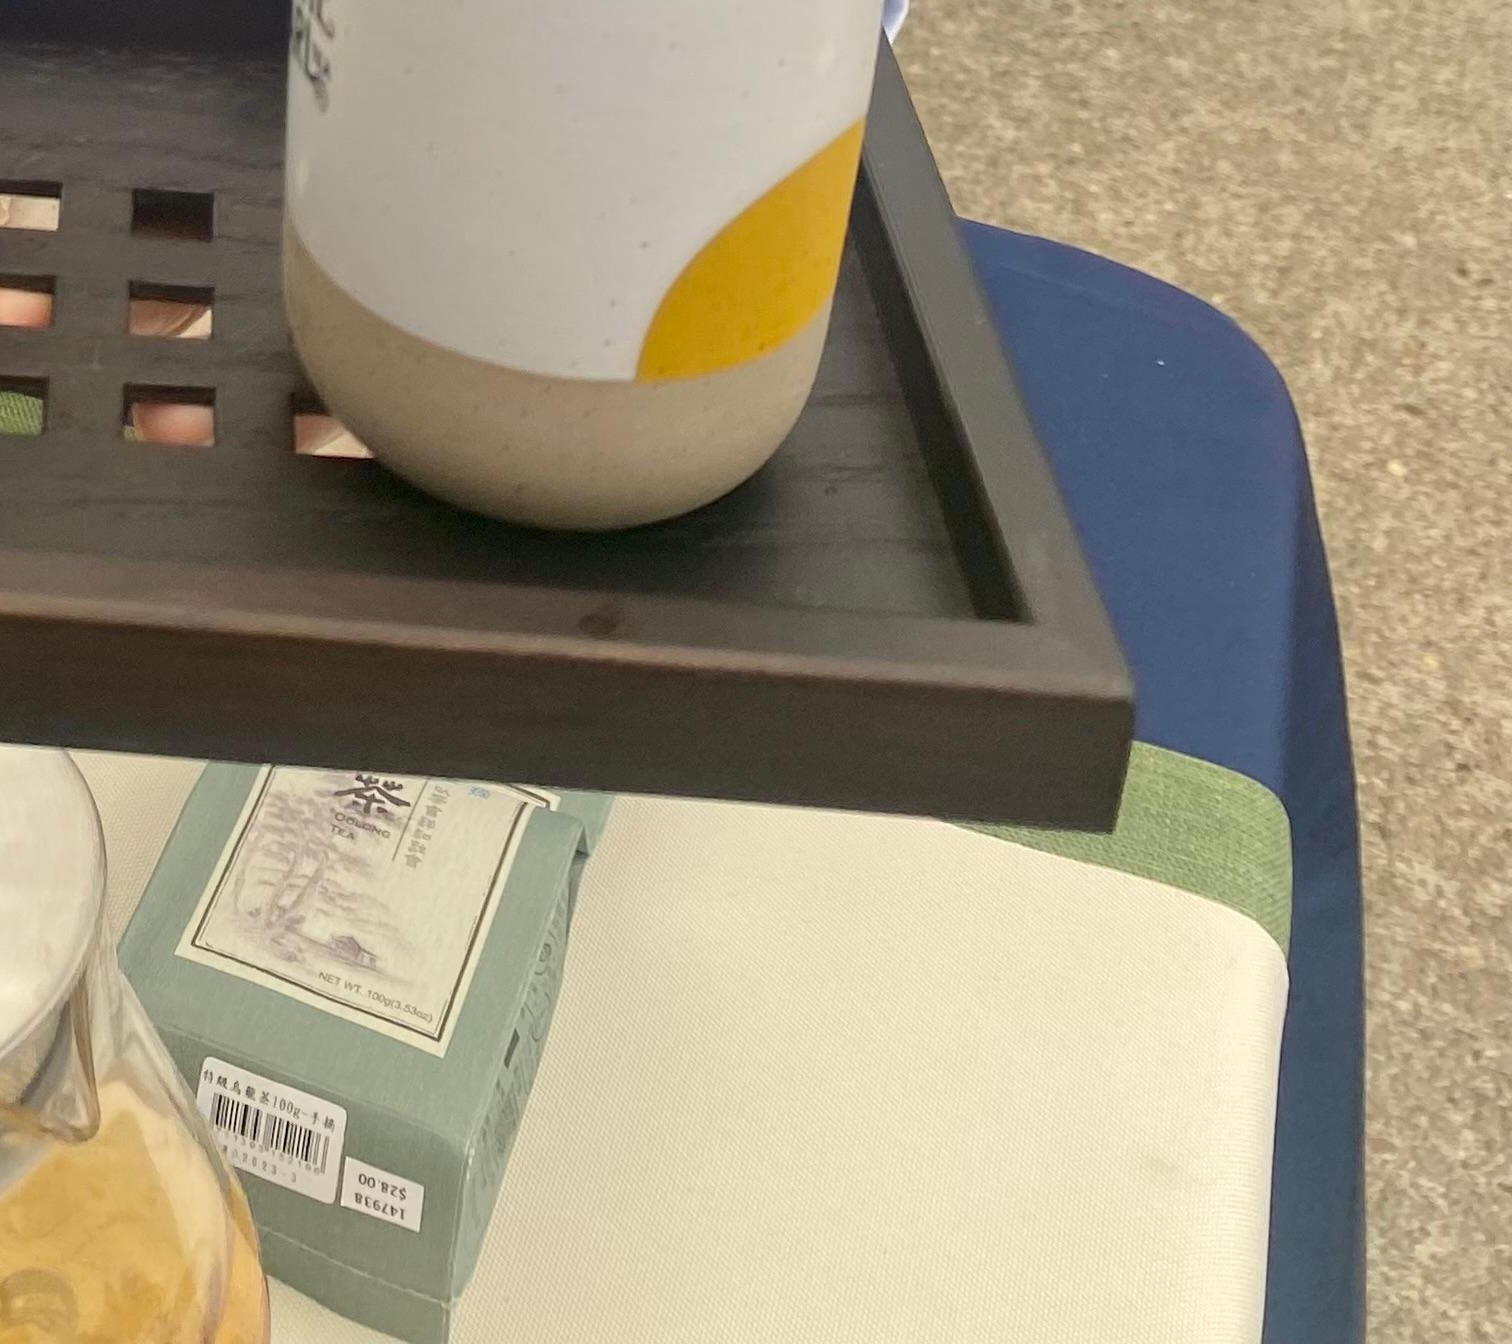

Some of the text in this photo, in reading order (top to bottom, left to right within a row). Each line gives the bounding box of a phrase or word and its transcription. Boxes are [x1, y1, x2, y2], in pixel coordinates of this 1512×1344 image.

[329, 823, 356, 842] TEA
[333, 811, 392, 840] OOLONG
[318, 971, 342, 986] NET
[357, 1171, 409, 1202] $28.00
[353, 1191, 407, 1222] 147938
